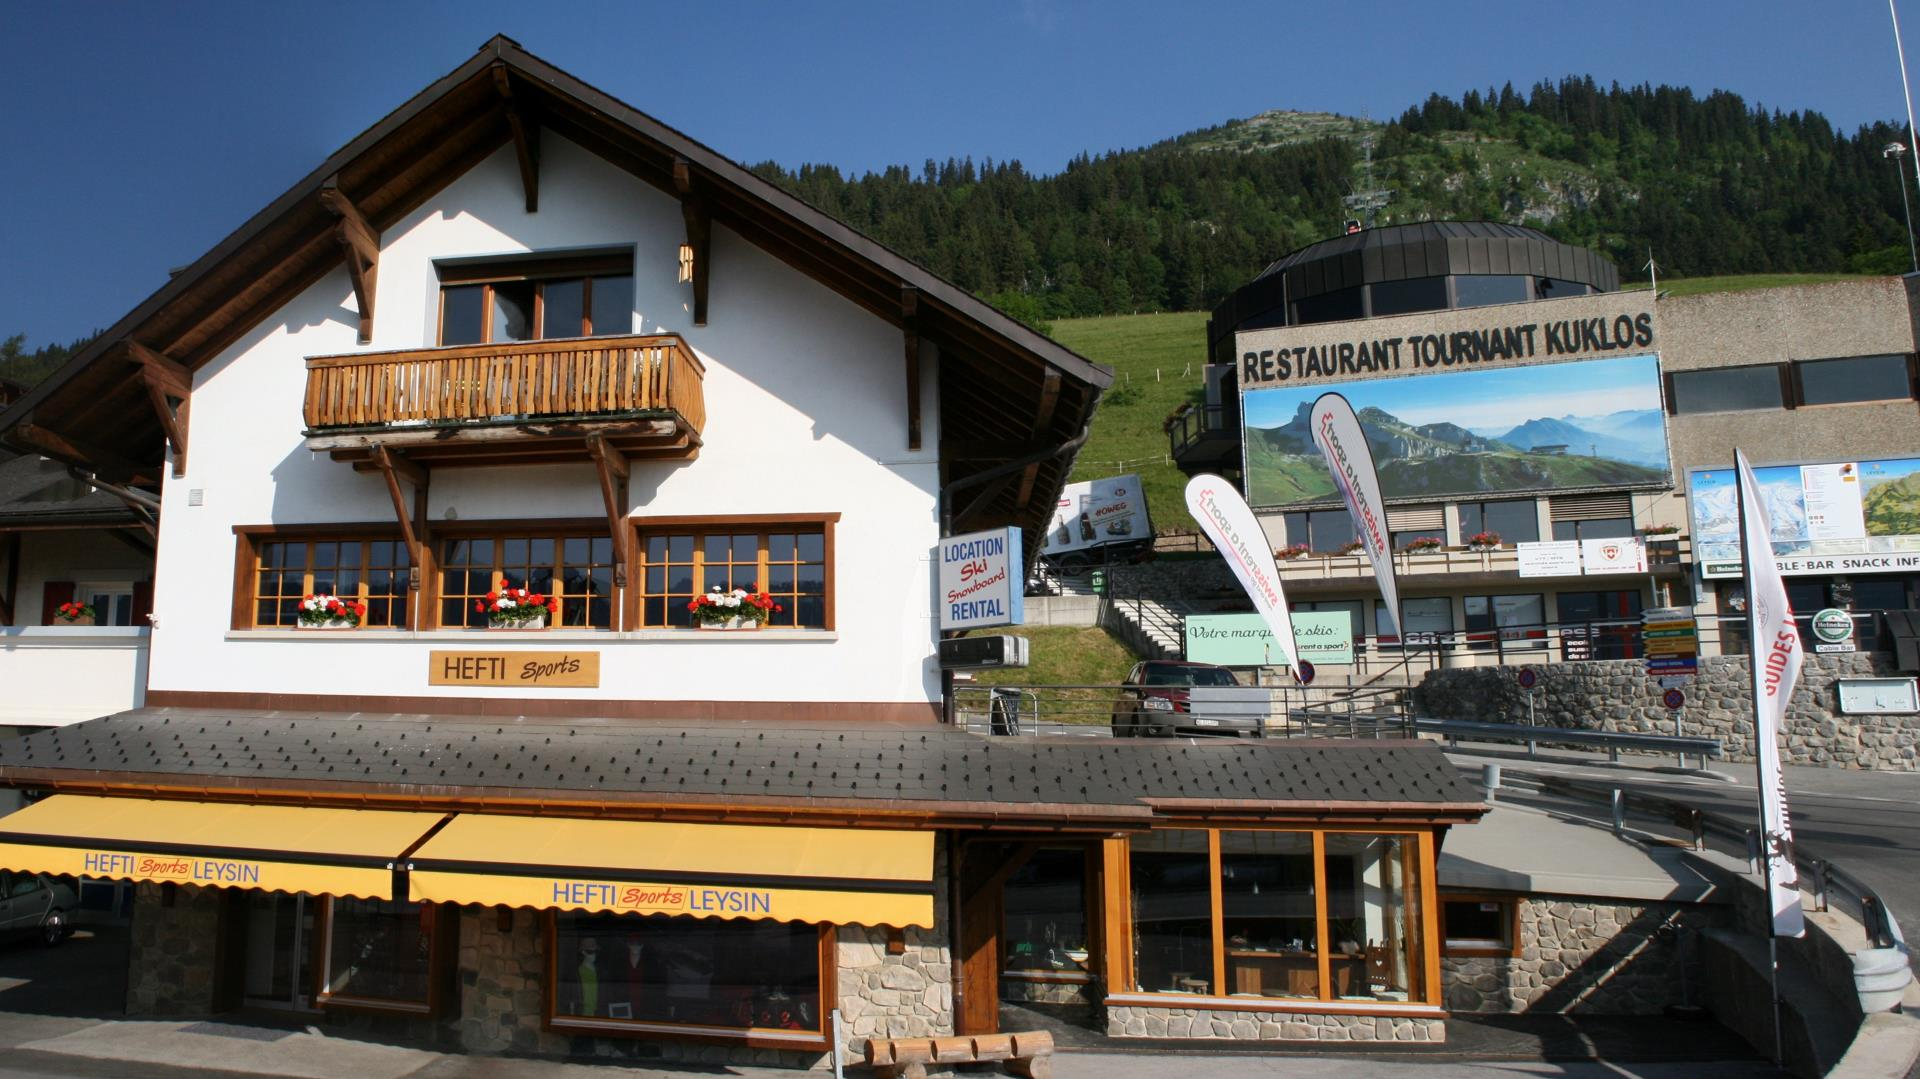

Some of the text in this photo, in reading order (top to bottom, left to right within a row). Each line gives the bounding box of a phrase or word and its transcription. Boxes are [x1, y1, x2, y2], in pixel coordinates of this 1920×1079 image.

[1243, 312, 1654, 383] RESTAURANT TOURNANT KUKLOS
[945, 537, 1003, 562] LOCATION
[961, 559, 987, 582] Ski
[1776, 560, 1834, 571] BLE-BAR
[1843, 558, 1890, 569] SNACK
[948, 566, 1005, 603] Snowboard
[952, 599, 1004, 621] RENTAL
[1190, 626, 1228, 639] Votre
[1231, 629, 1274, 640] marq
[1324, 643, 1344, 651] sport
[444, 655, 580, 683] HEFTI Sports
[85, 853, 259, 882] HEFTI Sports LEYSIN
[553, 882, 770, 912] HEFTI Sports LEYSIN
